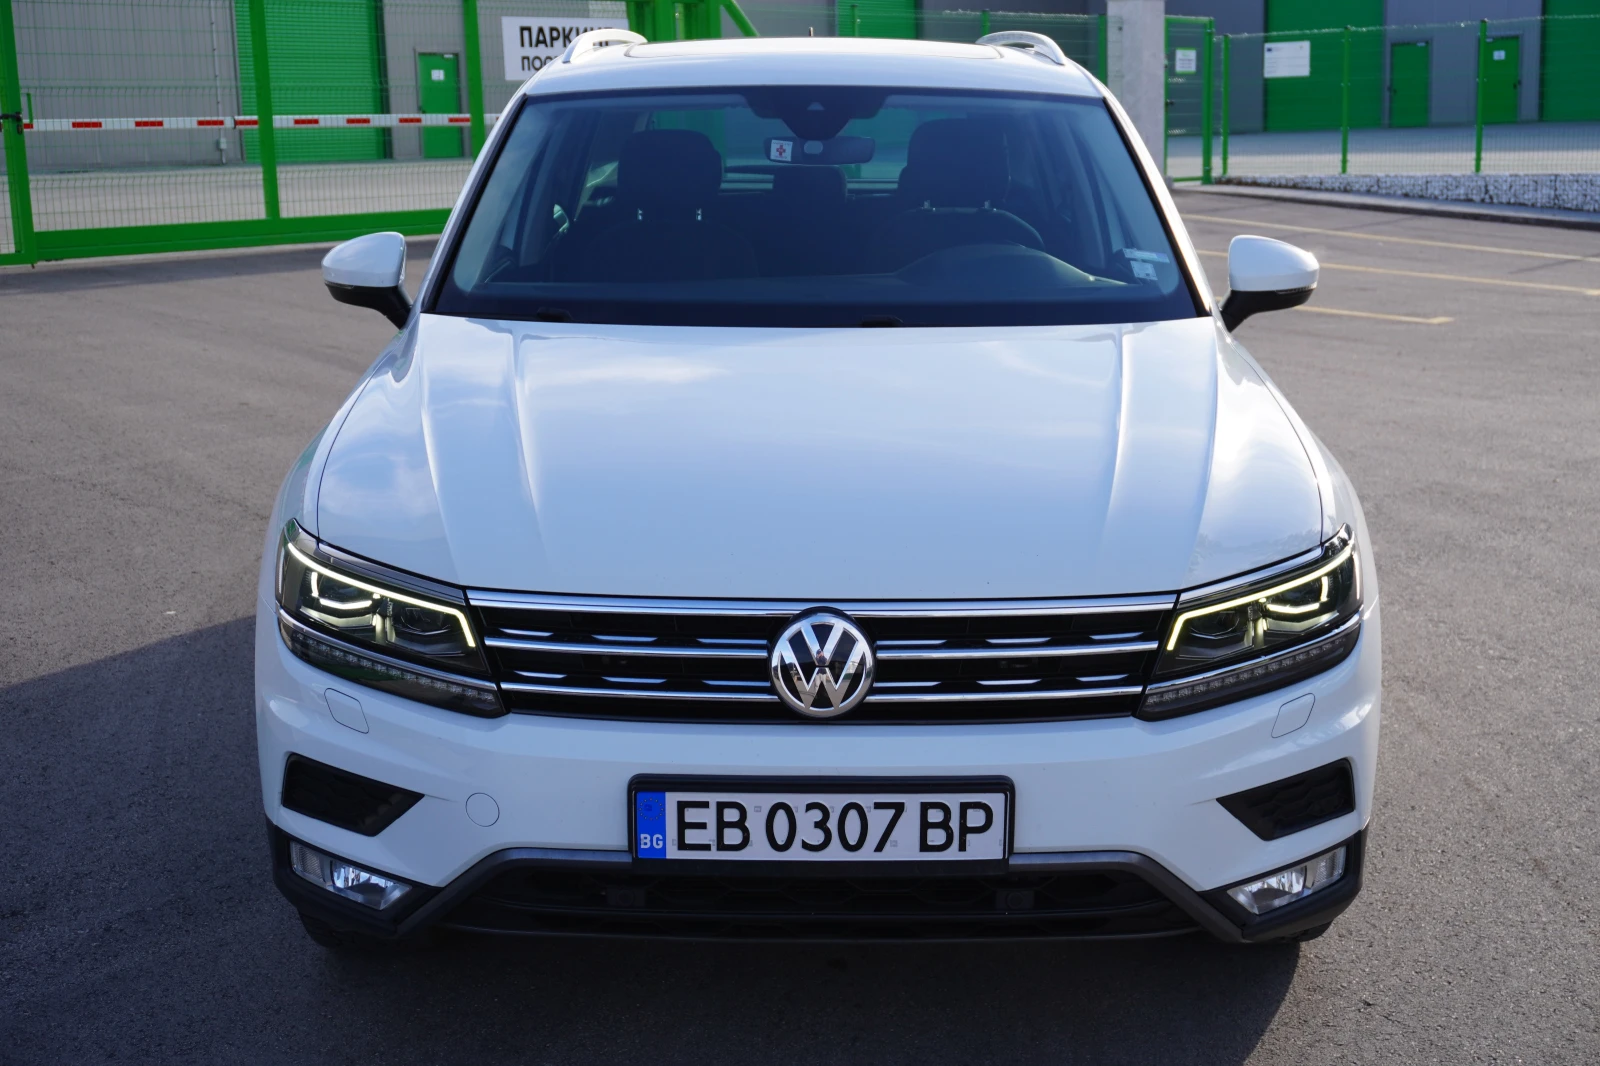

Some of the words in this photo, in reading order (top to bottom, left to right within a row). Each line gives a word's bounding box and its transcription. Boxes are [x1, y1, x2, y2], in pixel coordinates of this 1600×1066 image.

[519, 26, 613, 48] ПАРК
[677, 800, 750, 852] EB
[765, 801, 905, 853] 0307
[919, 801, 994, 853] BP
[640, 833, 663, 849] BG
